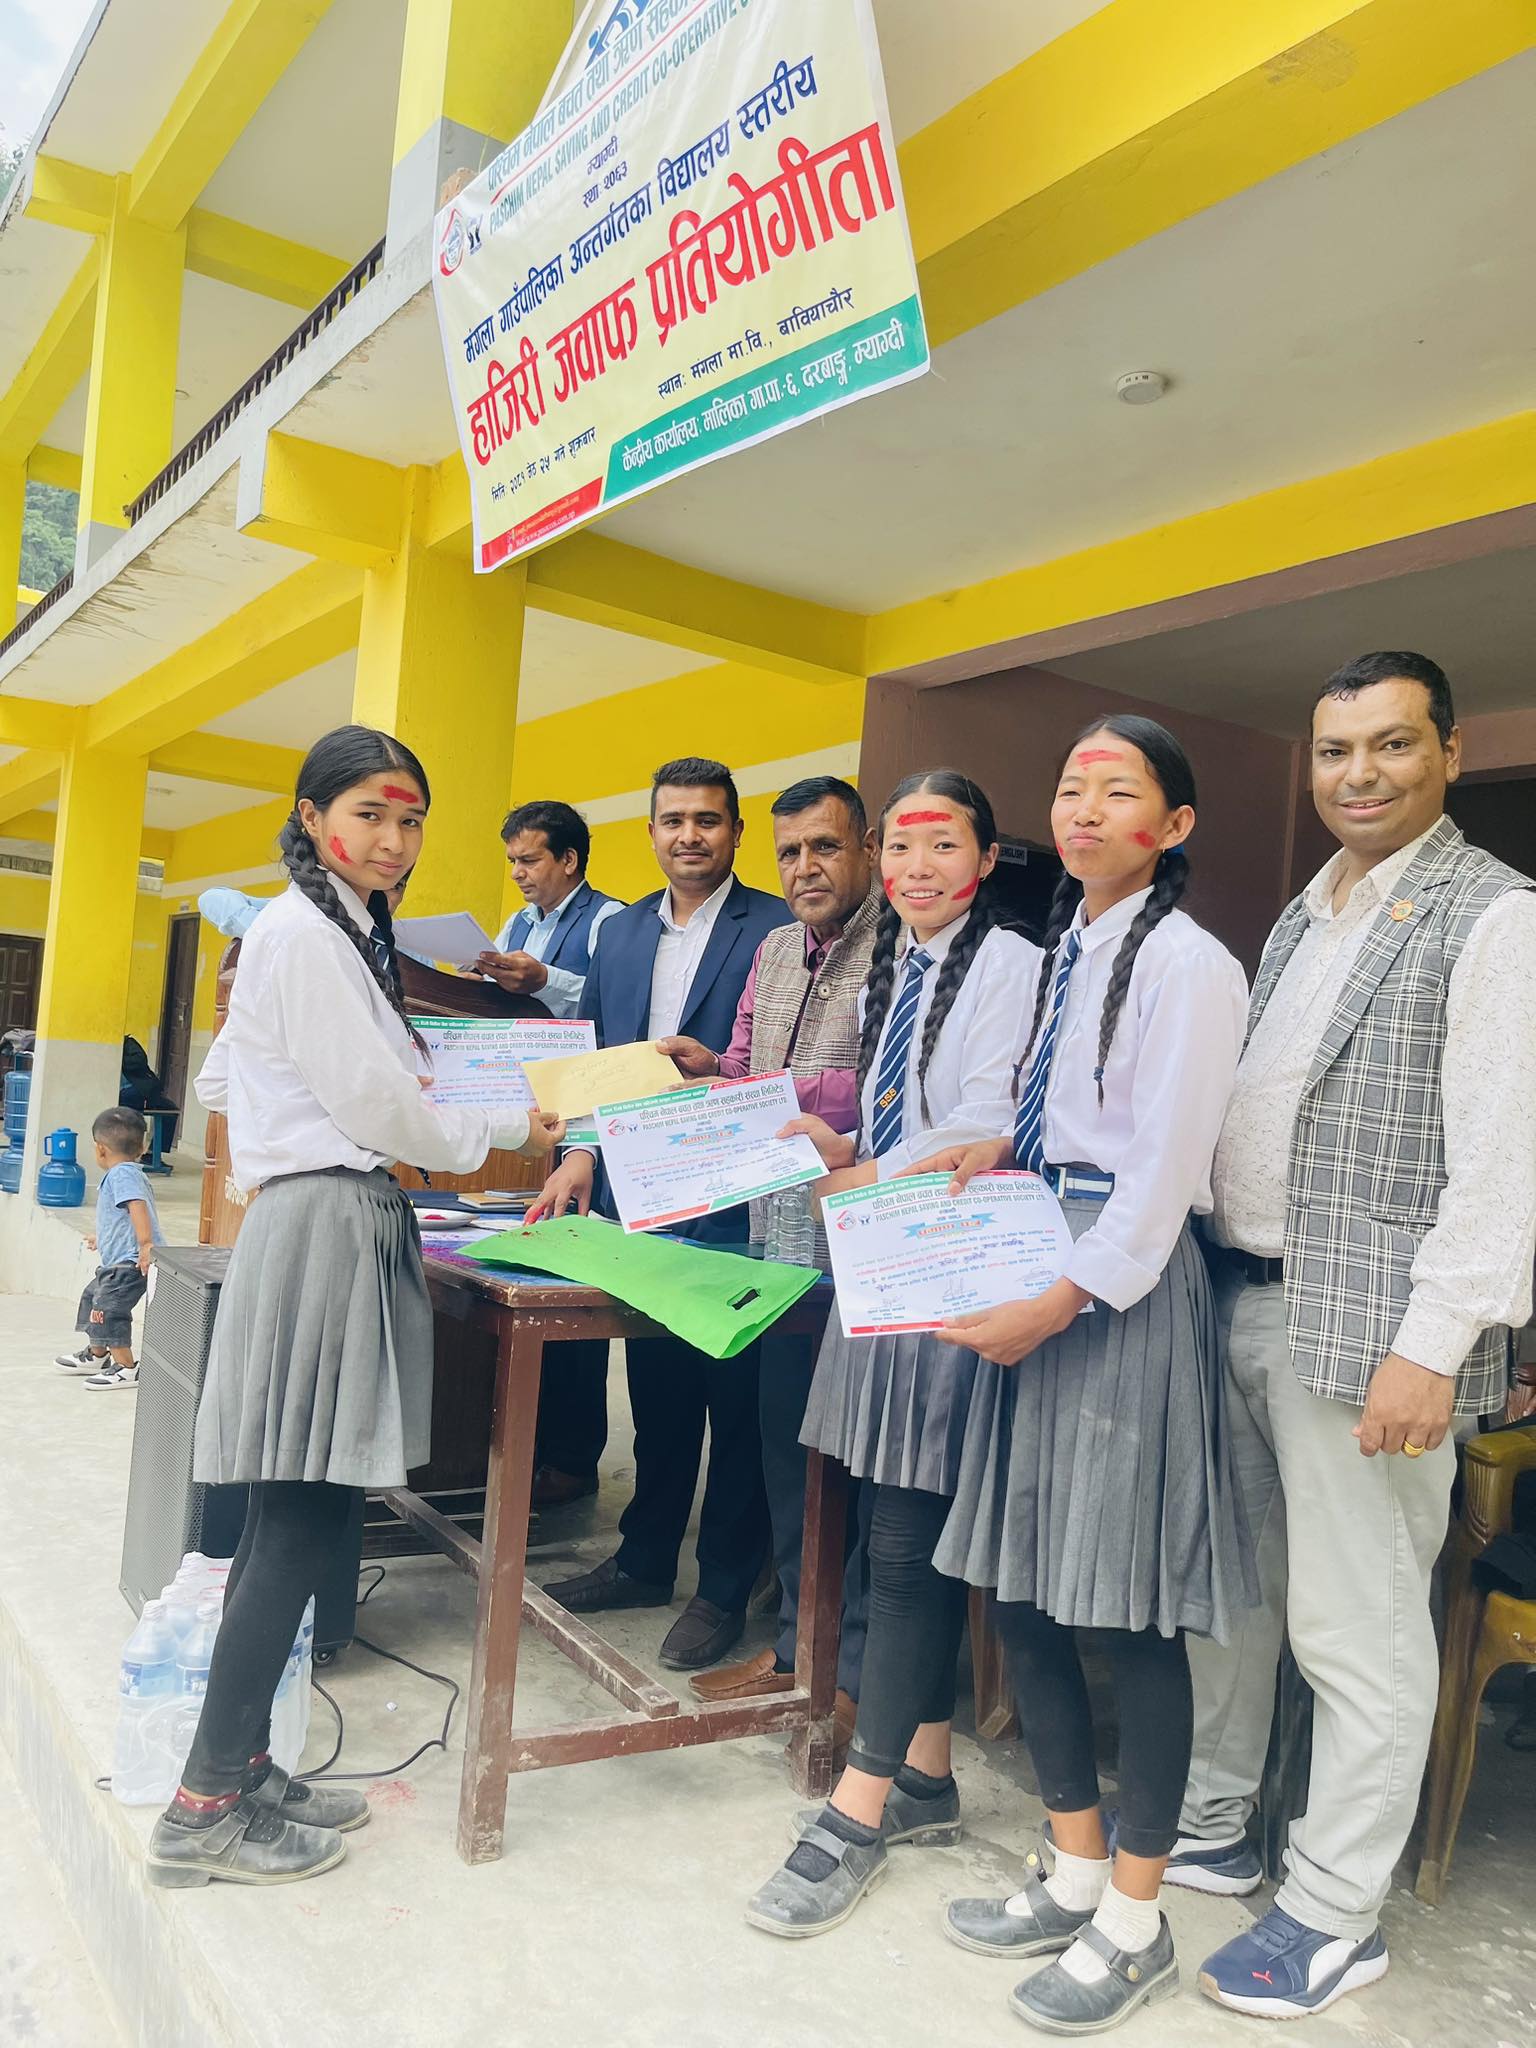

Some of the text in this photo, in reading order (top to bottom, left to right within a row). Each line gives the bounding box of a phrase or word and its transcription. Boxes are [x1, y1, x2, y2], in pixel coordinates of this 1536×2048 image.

[489, 0, 738, 235] PASCHIM NEPAL SAVING AND CREDIT CO-OPERATIVE
[557, 78, 585, 125] बचत
[586, 56, 610, 103] तथा
[587, 136, 618, 176] म्याग्दी
[604, 161, 628, 191] २०६३
[464, 55, 818, 364] मंगला गाउँपालिका अन्तर्गतका विद्यालय स्तरीय
[467, 121, 896, 466] हाजिरी जवाफ प्रतियोगीता
[657, 373, 687, 400] स्थान:
[690, 351, 723, 380] मंगला
[776, 287, 855, 336] बावियाचौर
[621, 439, 654, 473] केन्द्रीय
[653, 415, 703, 457] कार्यालय:
[701, 393, 748, 433] मालिका
[852, 317, 905, 366] म्याग्दी
[553, 443, 566, 463] गते
[725, 1103, 758, 1118] CO-OPERATIVE
[758, 1098, 778, 1110] SOCIETY
[875, 1208, 900, 1223] PASCHIM
[901, 1205, 918, 1218] NEPAL
[919, 1201, 939, 1215] SAVING
[939, 1200, 952, 1211] AND
[952, 1198, 973, 1210] CREDIT
[973, 1195, 1012, 1207] CO-OPERATIVE
[1013, 1193, 1036, 1203] SOCIETY
[967, 1178, 994, 1194] सहकारी
[1014, 1177, 1041, 1192] लिमिटेड
